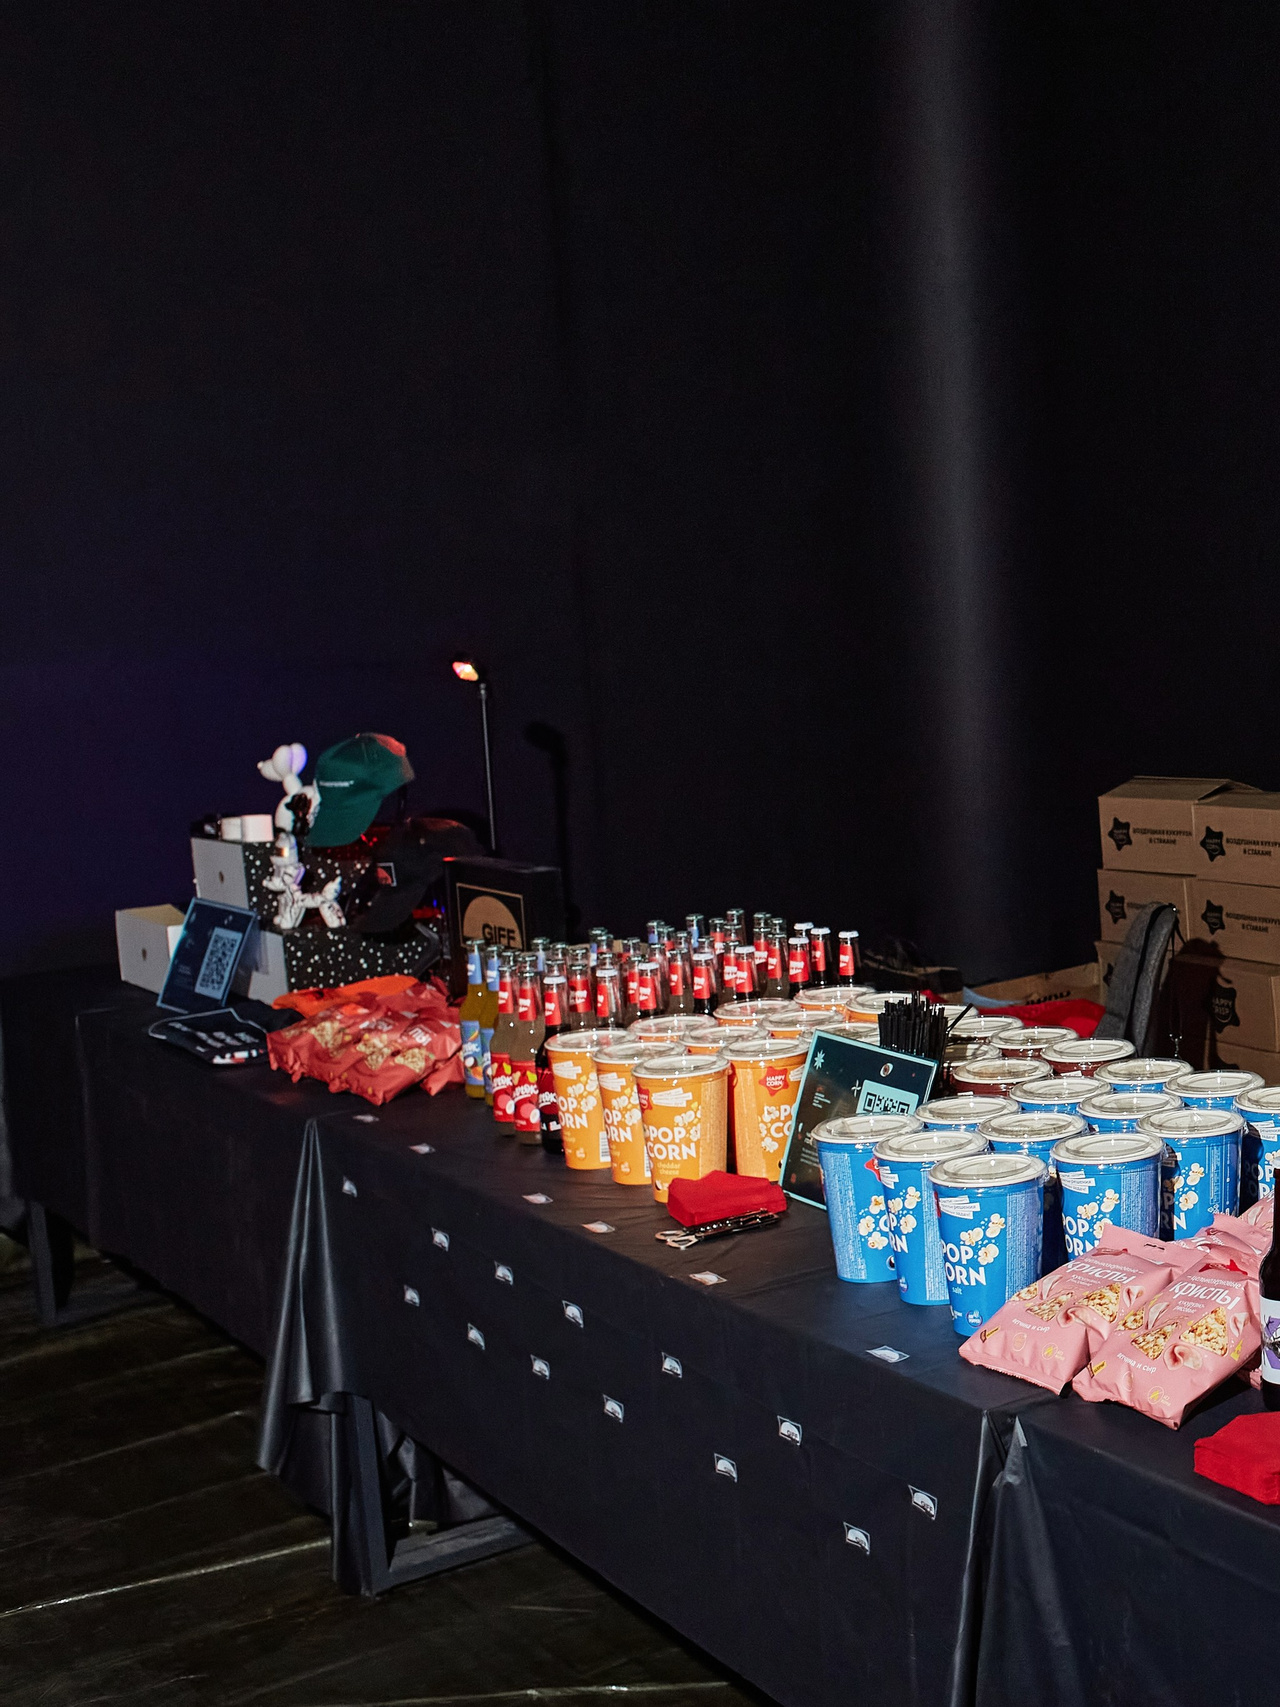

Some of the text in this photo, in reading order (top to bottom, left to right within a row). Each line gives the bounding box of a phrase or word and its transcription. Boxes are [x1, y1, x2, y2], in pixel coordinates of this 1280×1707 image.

[482, 923, 515, 947] GIFF
[558, 1096, 577, 1112] OP
[558, 1110, 588, 1129] ORN
[604, 1108, 622, 1125] OP
[649, 1126, 686, 1143] POP
[770, 1120, 792, 1138] CO
[647, 1142, 696, 1160] CORN
[1065, 1234, 1099, 1256] ORN
[945, 1262, 986, 1286] ORN
[1169, 1281, 1241, 1310] КРИСПЫ
[1037, 1325, 1050, 1333] сыр
[1142, 1363, 1157, 1374] сыр
